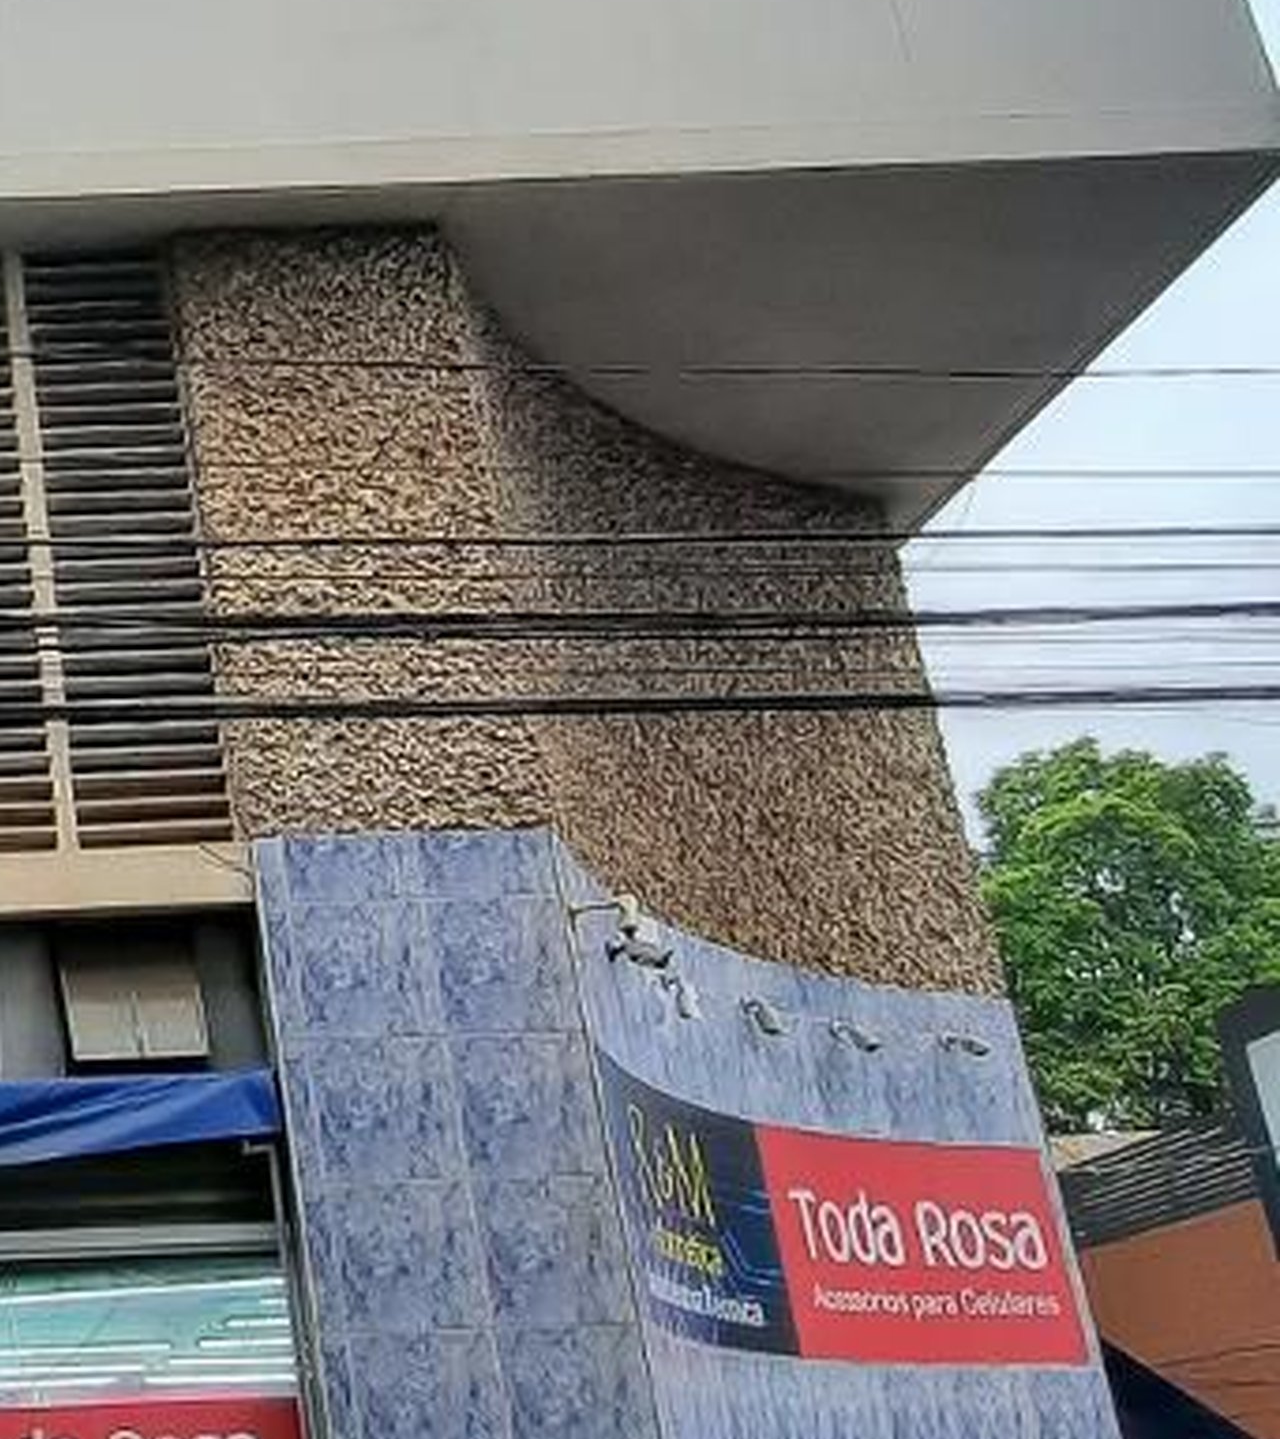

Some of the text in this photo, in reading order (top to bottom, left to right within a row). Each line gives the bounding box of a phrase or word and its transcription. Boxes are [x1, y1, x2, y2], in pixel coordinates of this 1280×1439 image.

[789, 1188, 1047, 1270] Toda Rosa
[912, 1293, 958, 1320] para
